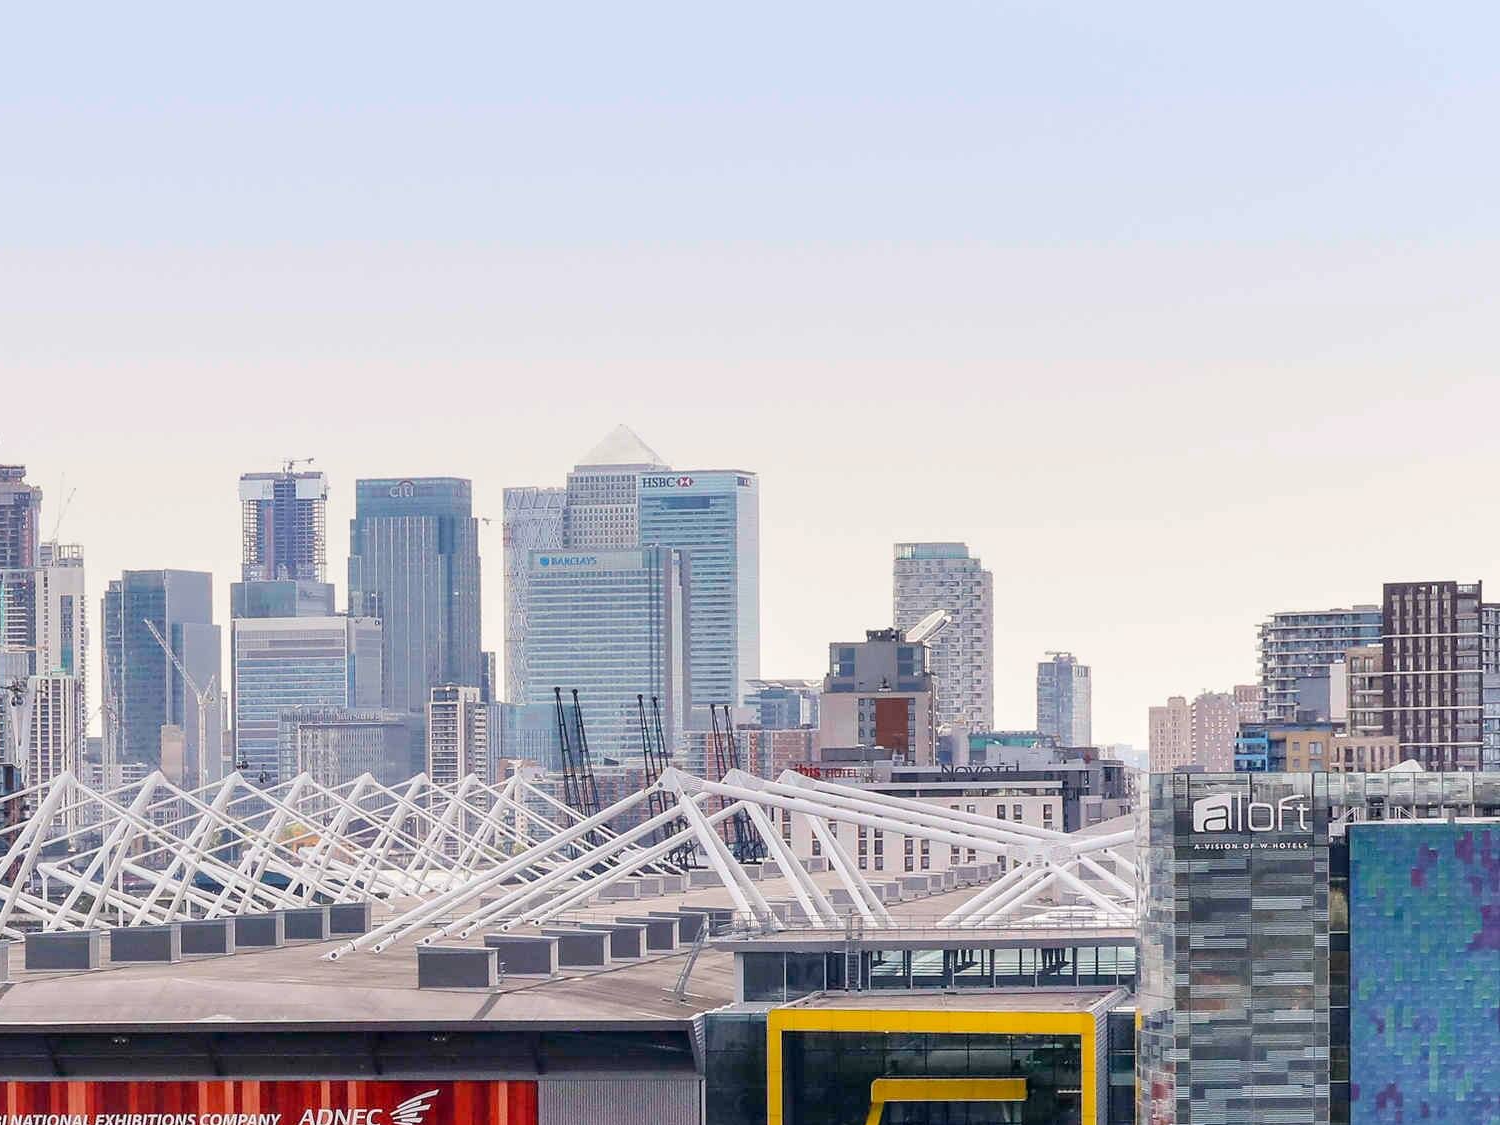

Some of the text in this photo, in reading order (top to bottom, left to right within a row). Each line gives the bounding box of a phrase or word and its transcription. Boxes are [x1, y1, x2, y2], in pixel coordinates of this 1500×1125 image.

[641, 476, 676, 489] HSBC
[551, 556, 597, 566] BARCLAYS
[826, 768, 859, 778] HOTEL
[1193, 791, 1310, 832] aloft
[1273, 842, 1309, 850] HOTELS
